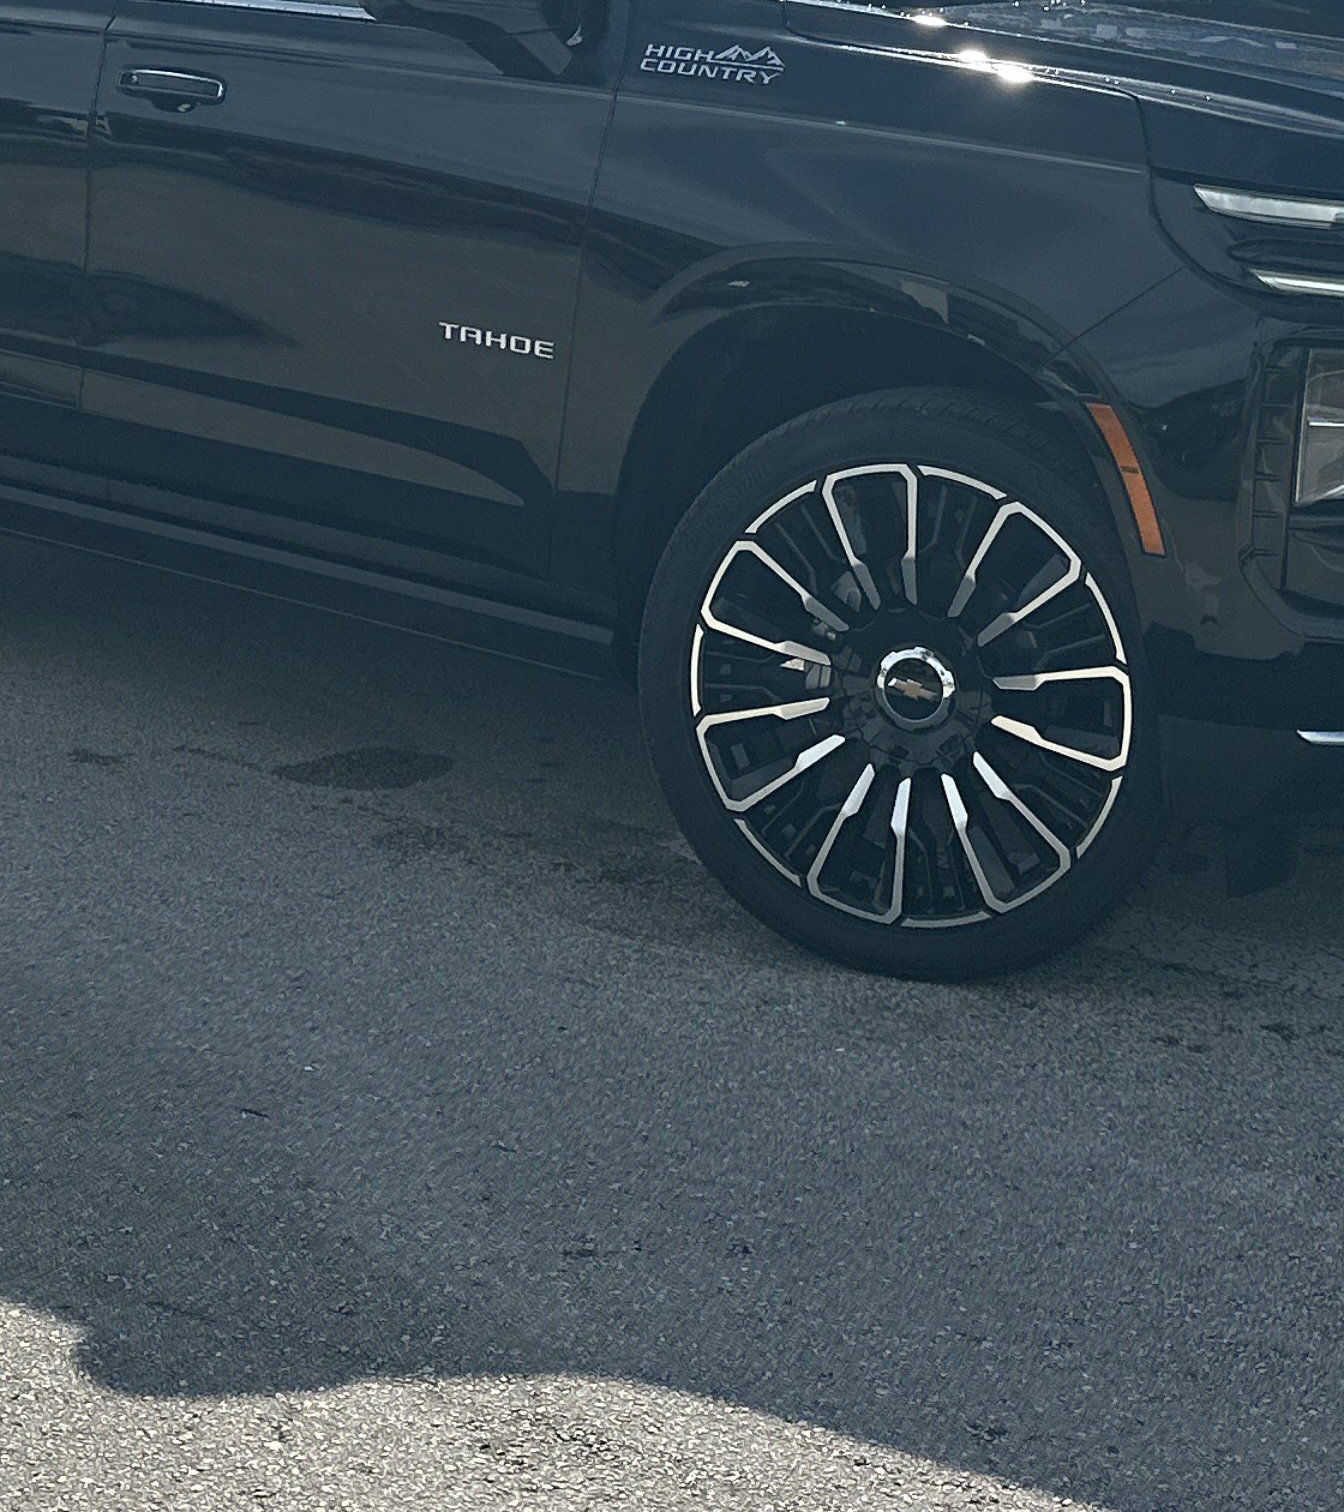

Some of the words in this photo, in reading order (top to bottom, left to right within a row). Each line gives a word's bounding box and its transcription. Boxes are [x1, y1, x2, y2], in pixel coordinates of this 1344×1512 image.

[644, 43, 715, 62] HIGH
[640, 57, 782, 85] COUNTRY
[438, 321, 556, 360] TAHOE
